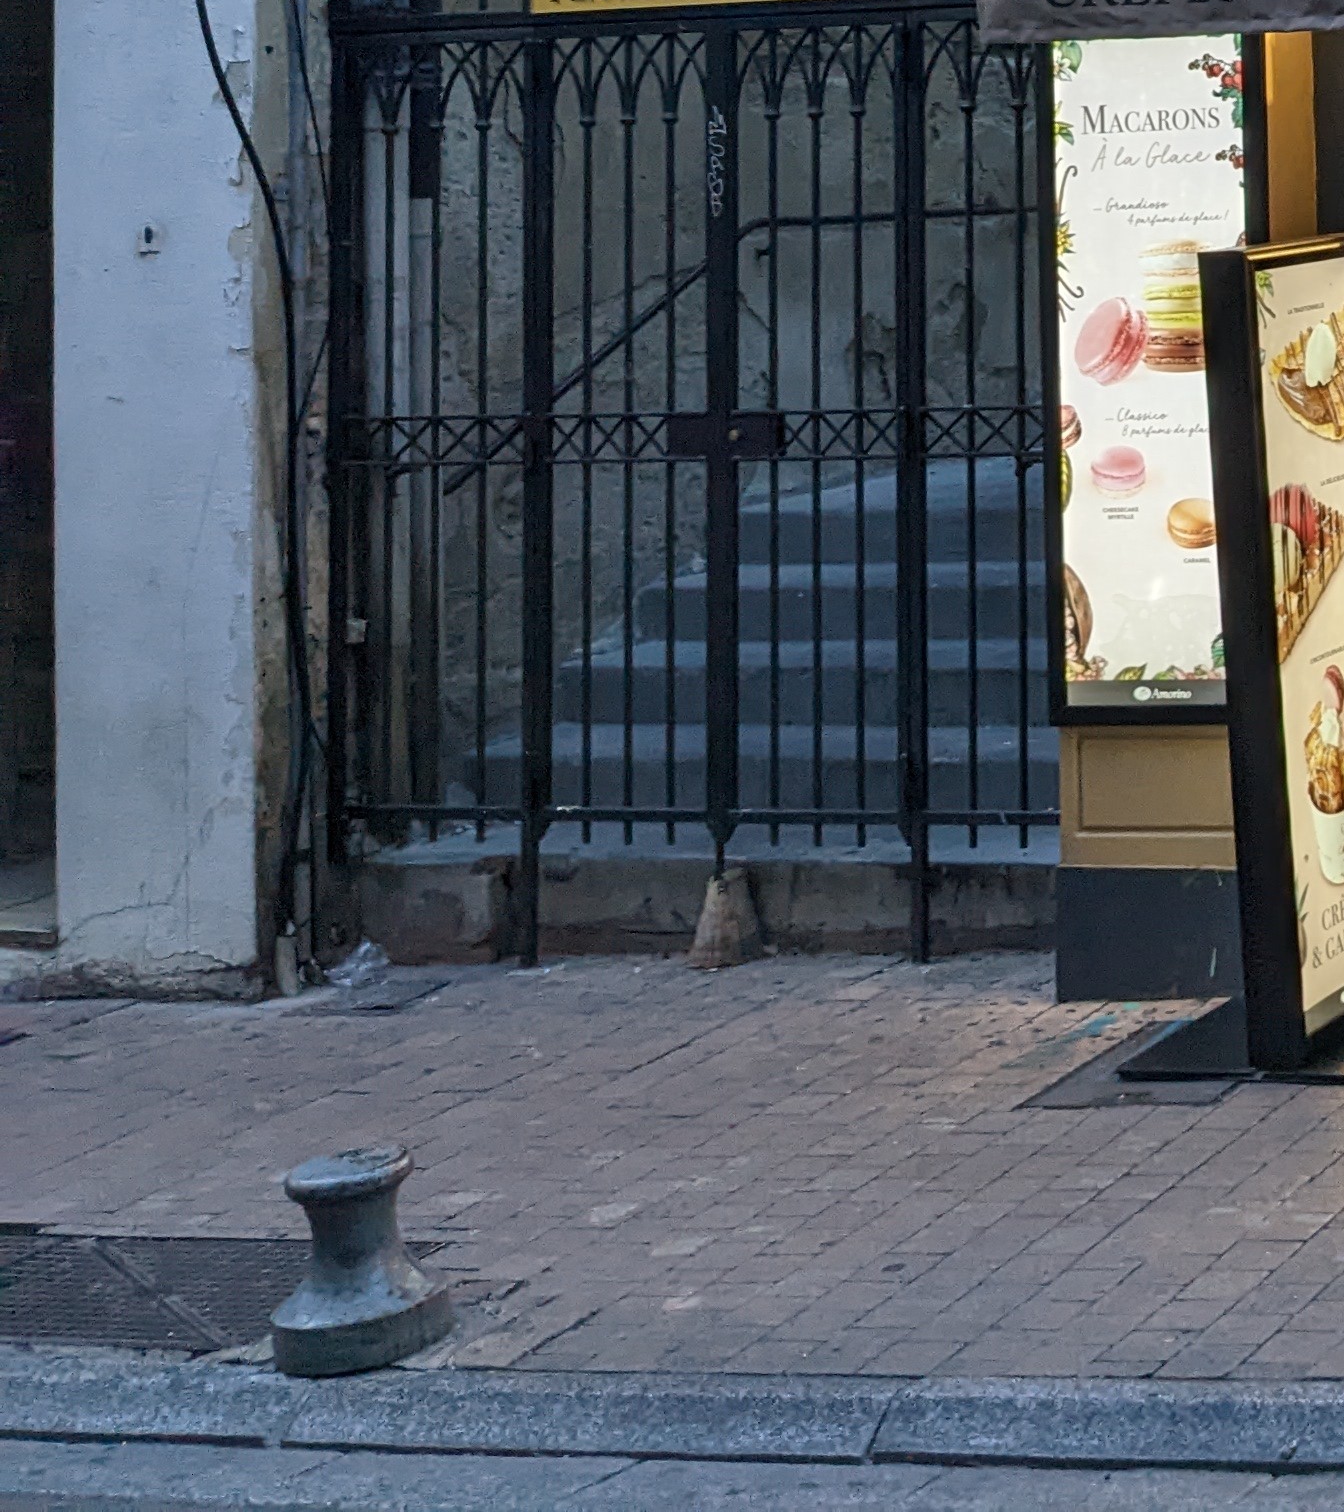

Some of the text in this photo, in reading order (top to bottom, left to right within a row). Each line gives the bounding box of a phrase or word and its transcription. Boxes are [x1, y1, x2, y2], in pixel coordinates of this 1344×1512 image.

[1114, 145, 1141, 167] la
[1145, 141, 1212, 169] Glace
[1105, 196, 1170, 214] Grandioso
[1135, 213, 1176, 227] parfums
[1177, 211, 1193, 223] de
[1116, 407, 1169, 423] Classico
[1121, 423, 1209, 438] 8 parfums de gla
[1150, 688, 1193, 700] Amorino
[1311, 946, 1323, 969] &
